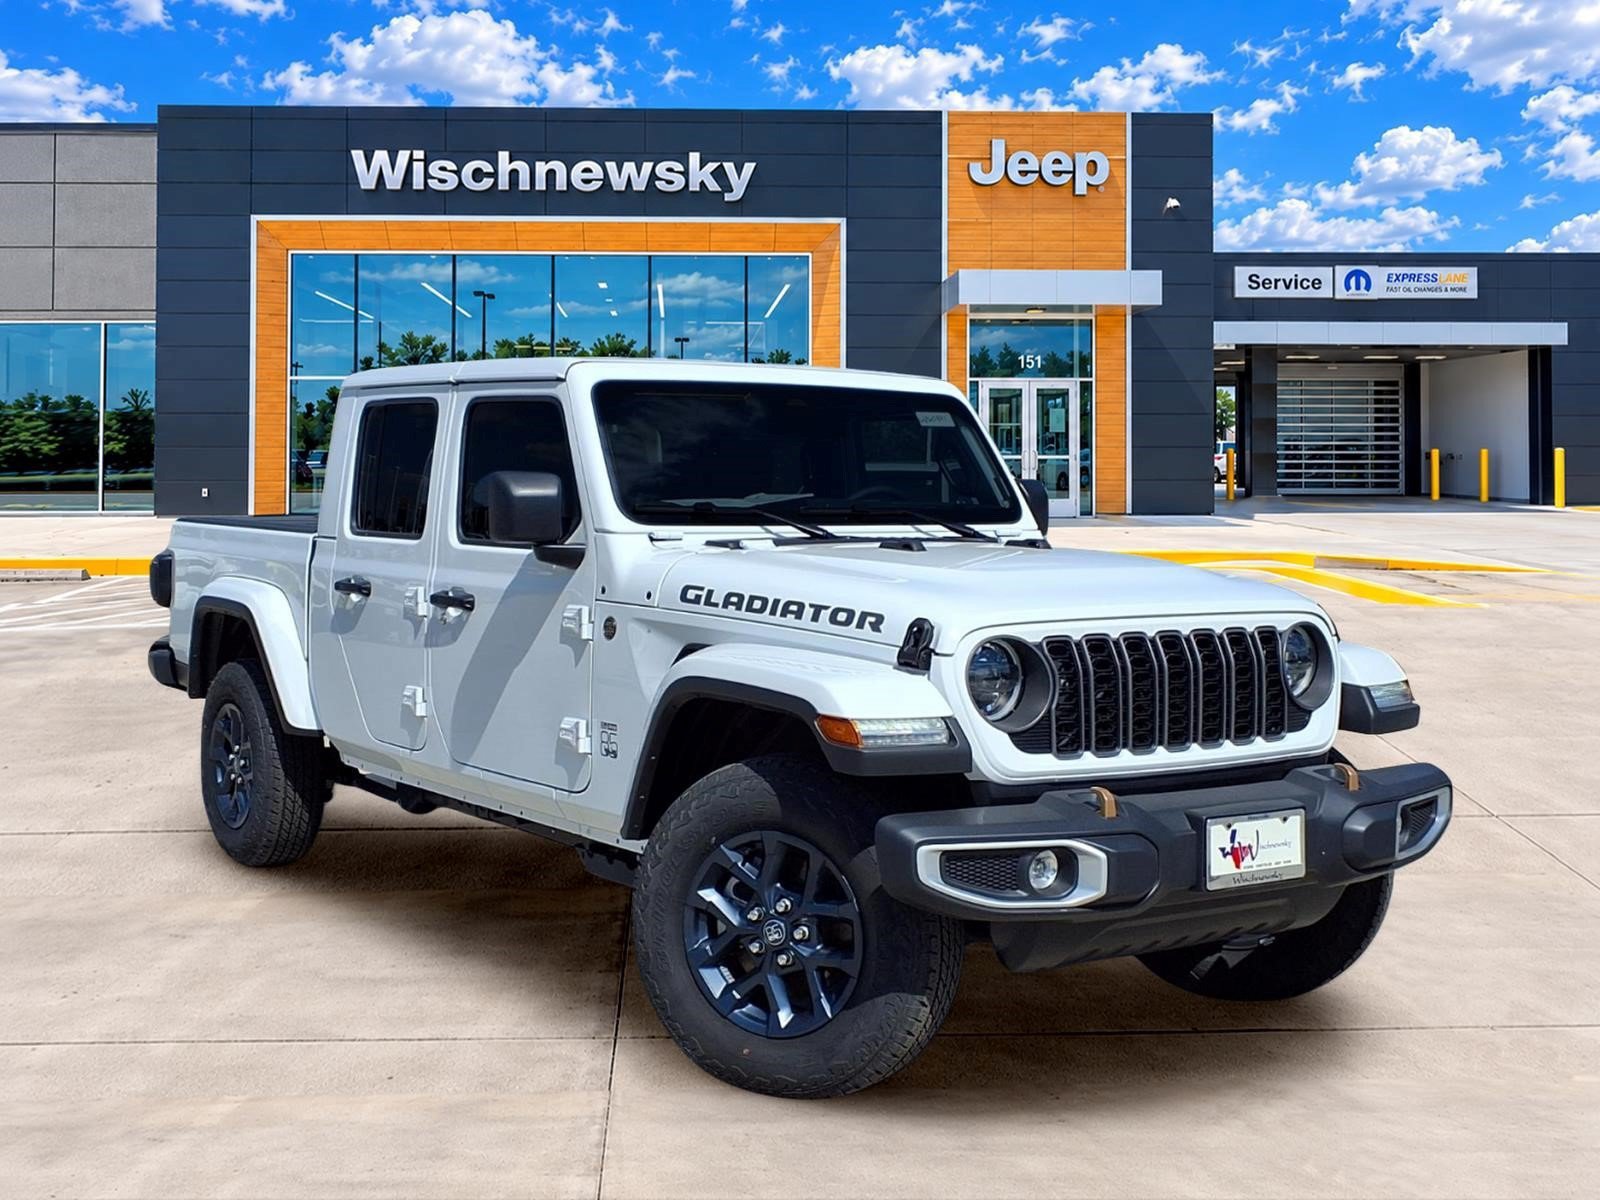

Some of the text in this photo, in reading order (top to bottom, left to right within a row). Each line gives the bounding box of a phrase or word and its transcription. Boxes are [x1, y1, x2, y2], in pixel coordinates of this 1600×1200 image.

[351, 149, 757, 202] Wischnewsky
[968, 138, 1110, 196] Jeep
[1247, 273, 1323, 290] Service
[1018, 355, 1042, 369] 151
[679, 584, 886, 634] GLADIATOR
